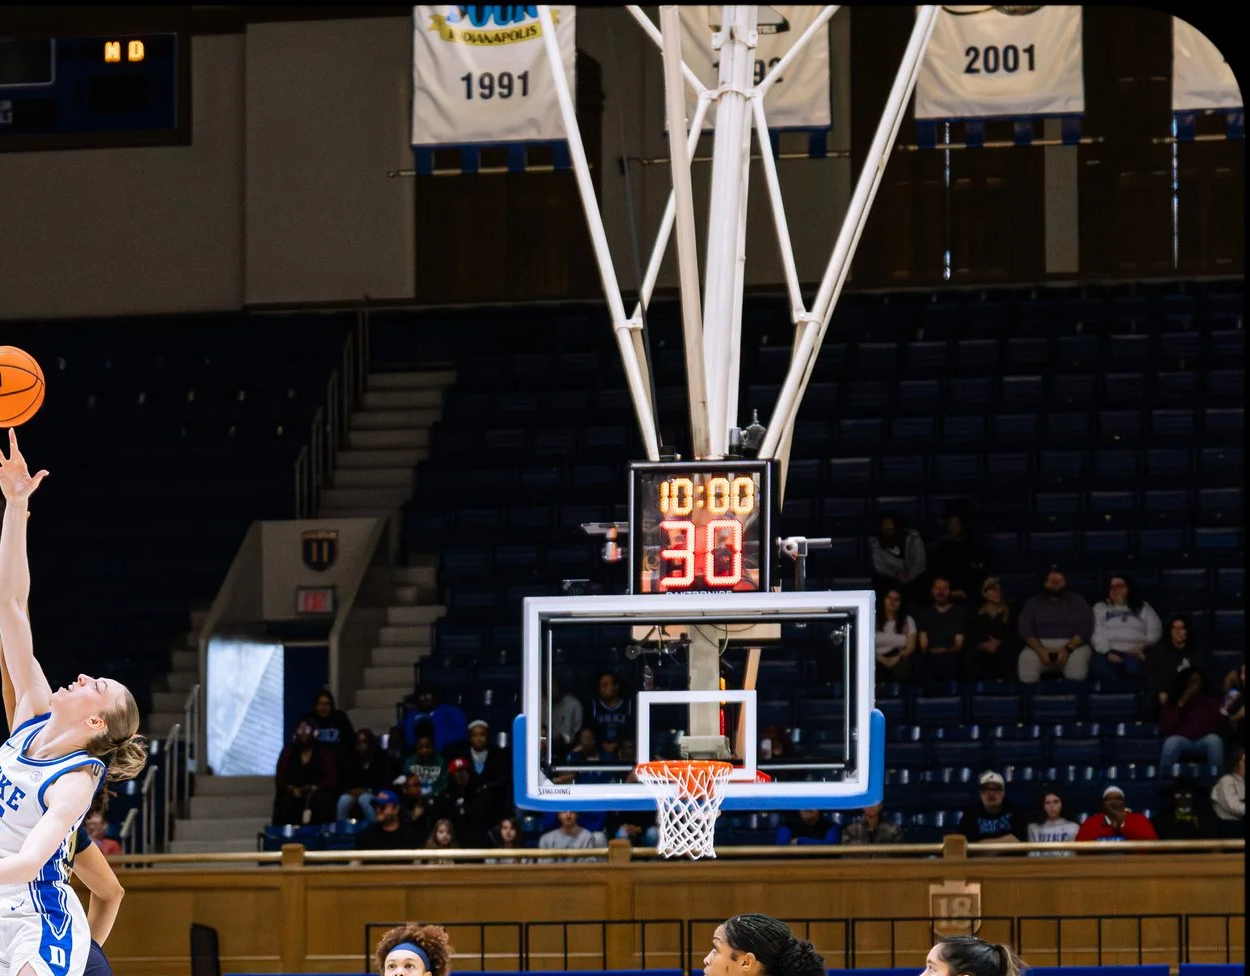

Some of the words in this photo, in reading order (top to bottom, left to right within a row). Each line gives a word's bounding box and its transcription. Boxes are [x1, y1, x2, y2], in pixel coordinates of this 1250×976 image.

[449, 25, 538, 44] IDIANAPOLIS
[964, 44, 1036, 74] 2001
[460, 71, 530, 100] 1991
[660, 477, 754, 516] 10:00
[659, 519, 743, 587] 30
[538, 787, 571, 796] SPALDING
[939, 897, 972, 927] 18
[48, 944, 66, 968] D
